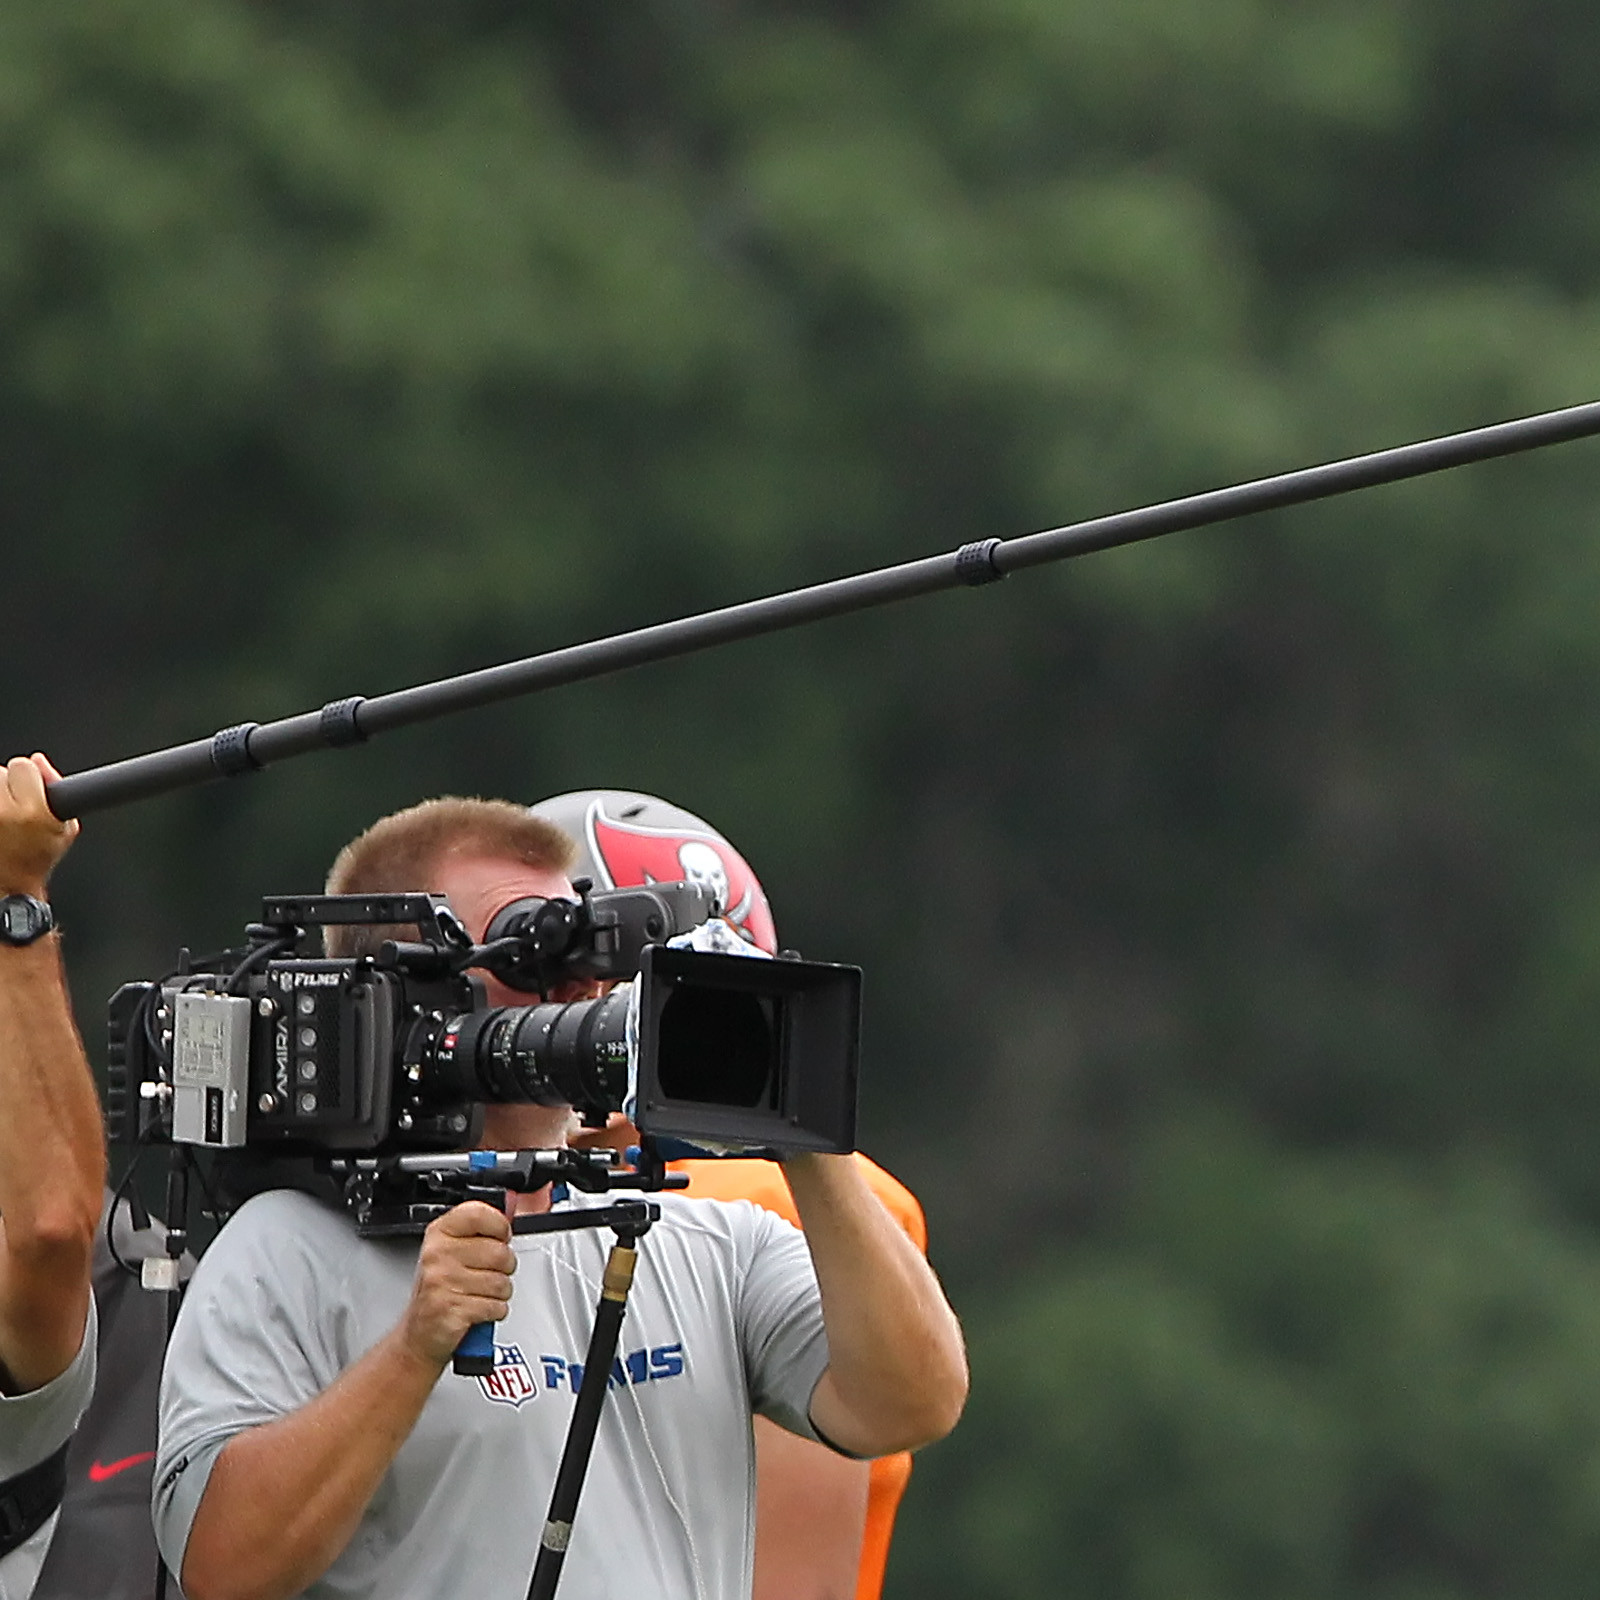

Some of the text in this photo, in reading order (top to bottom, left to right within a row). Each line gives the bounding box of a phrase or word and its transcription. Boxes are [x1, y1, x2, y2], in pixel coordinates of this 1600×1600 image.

[294, 972, 340, 987] FILMS
[276, 1016, 289, 1097] AMIRA
[485, 1367, 532, 1399] NFL
[540, 1342, 683, 1394] FIMS
